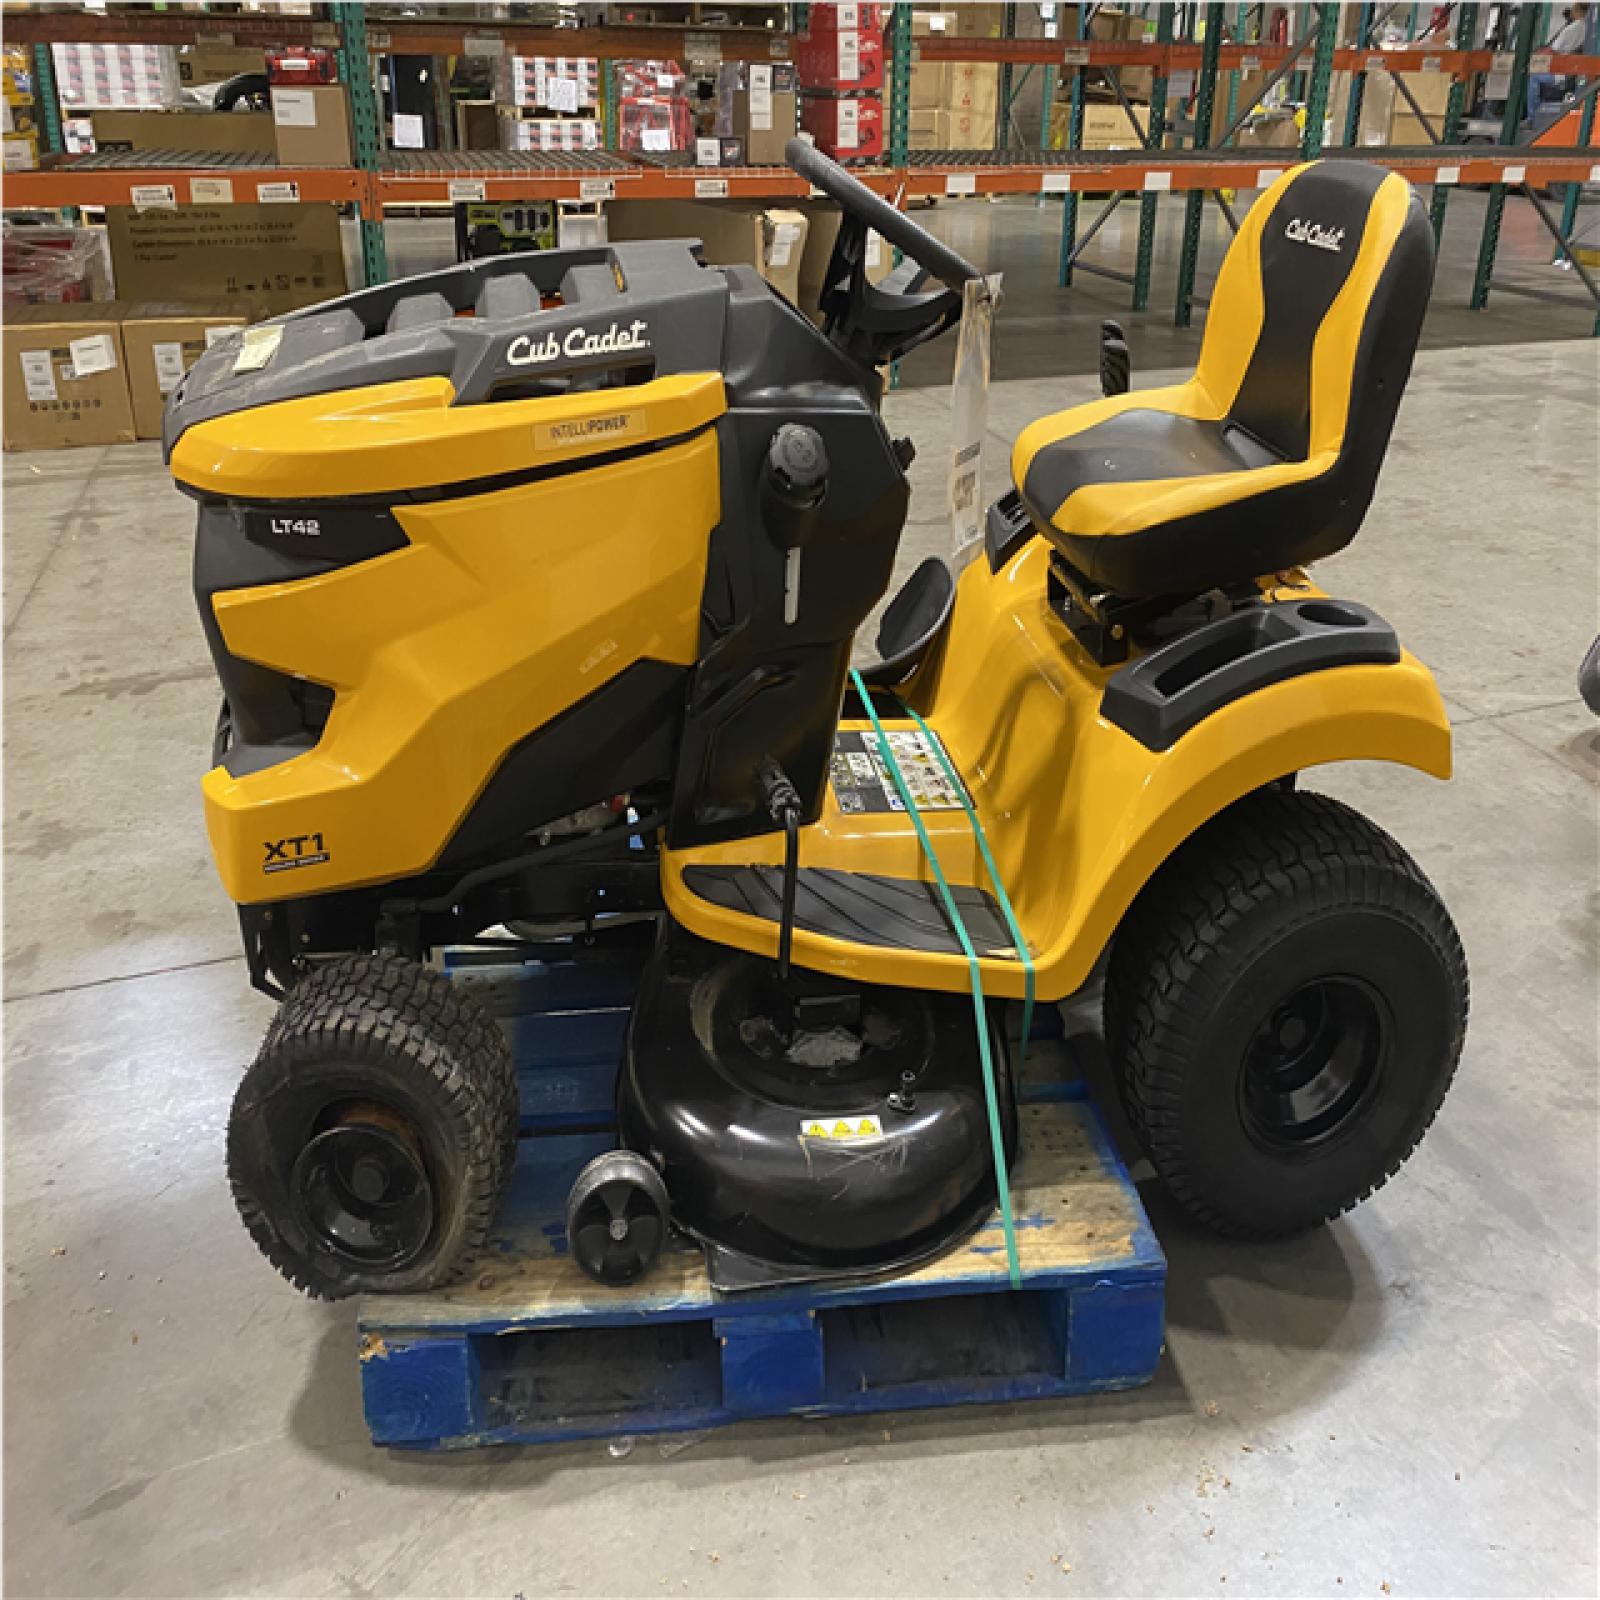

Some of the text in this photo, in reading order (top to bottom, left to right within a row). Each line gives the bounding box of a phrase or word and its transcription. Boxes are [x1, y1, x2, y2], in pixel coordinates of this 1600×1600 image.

[507, 319, 647, 365] Cub Cadet
[271, 519, 320, 535] LT42
[263, 832, 323, 861] XT1
